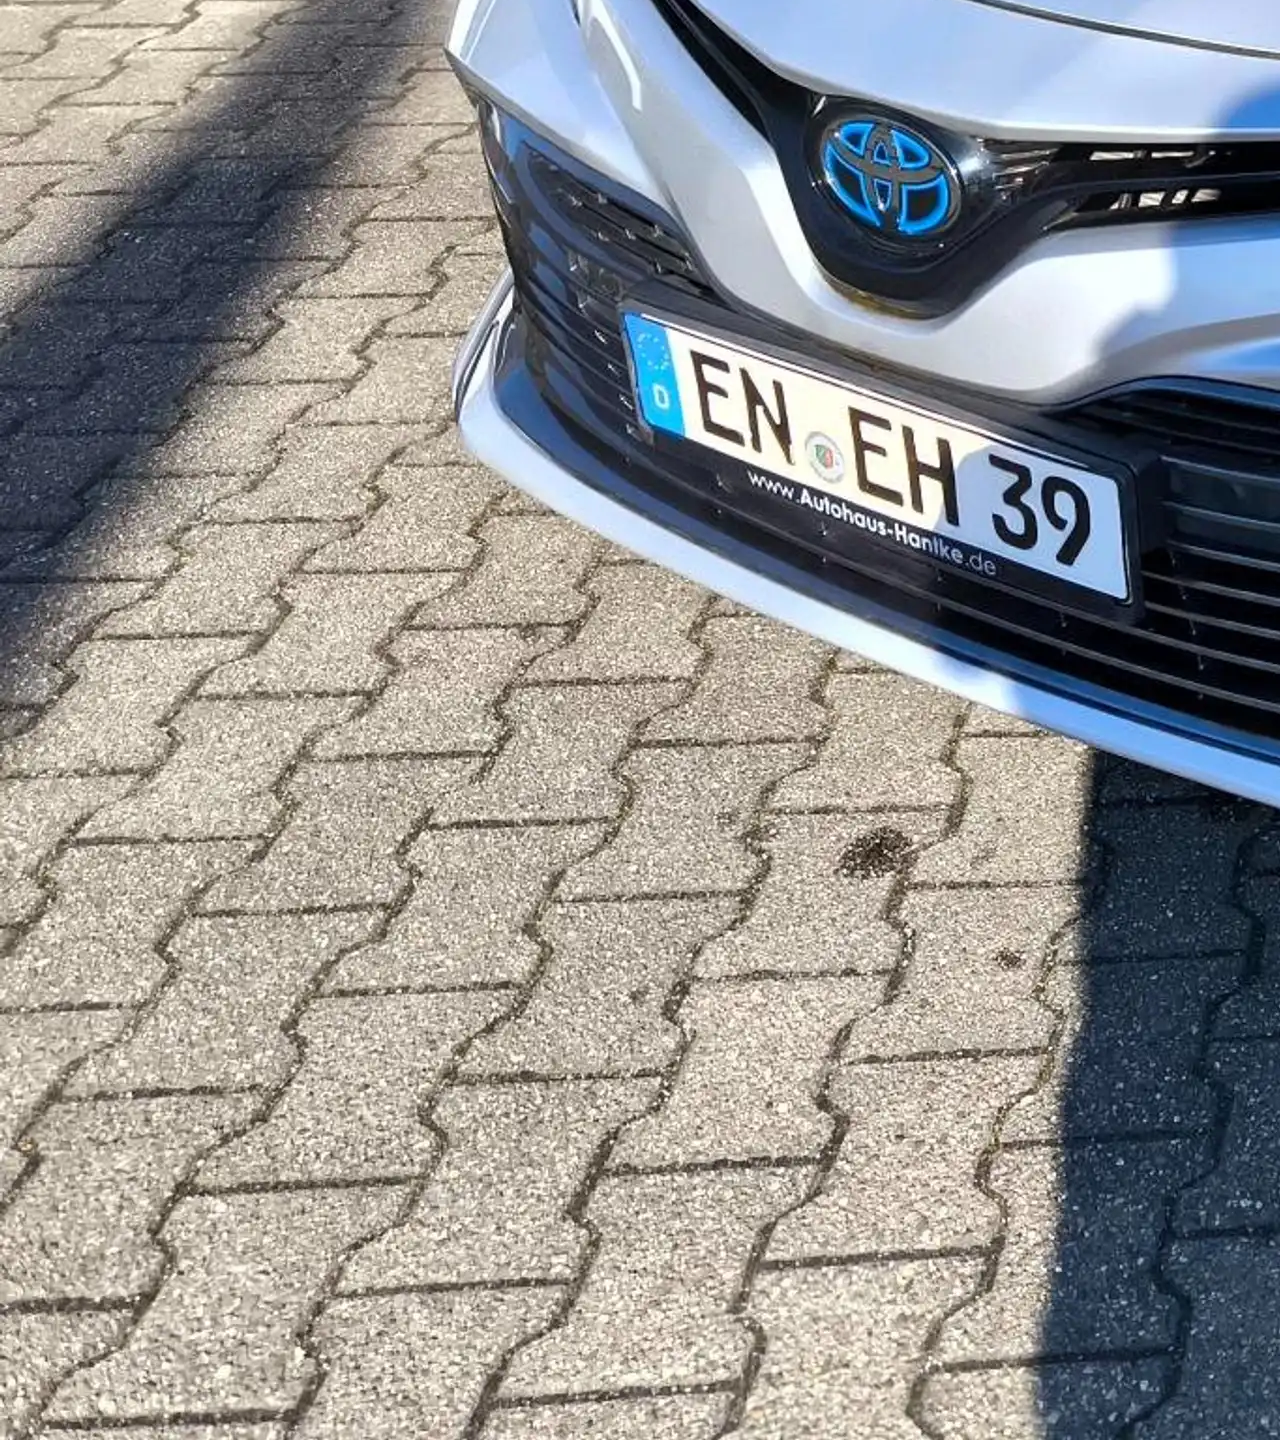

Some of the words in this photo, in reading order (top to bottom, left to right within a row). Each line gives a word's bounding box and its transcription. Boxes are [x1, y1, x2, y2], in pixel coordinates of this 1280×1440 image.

[653, 383, 670, 409] D
[690, 348, 796, 465] EN
[848, 405, 960, 526] EH
[987, 453, 1091, 566] 39
